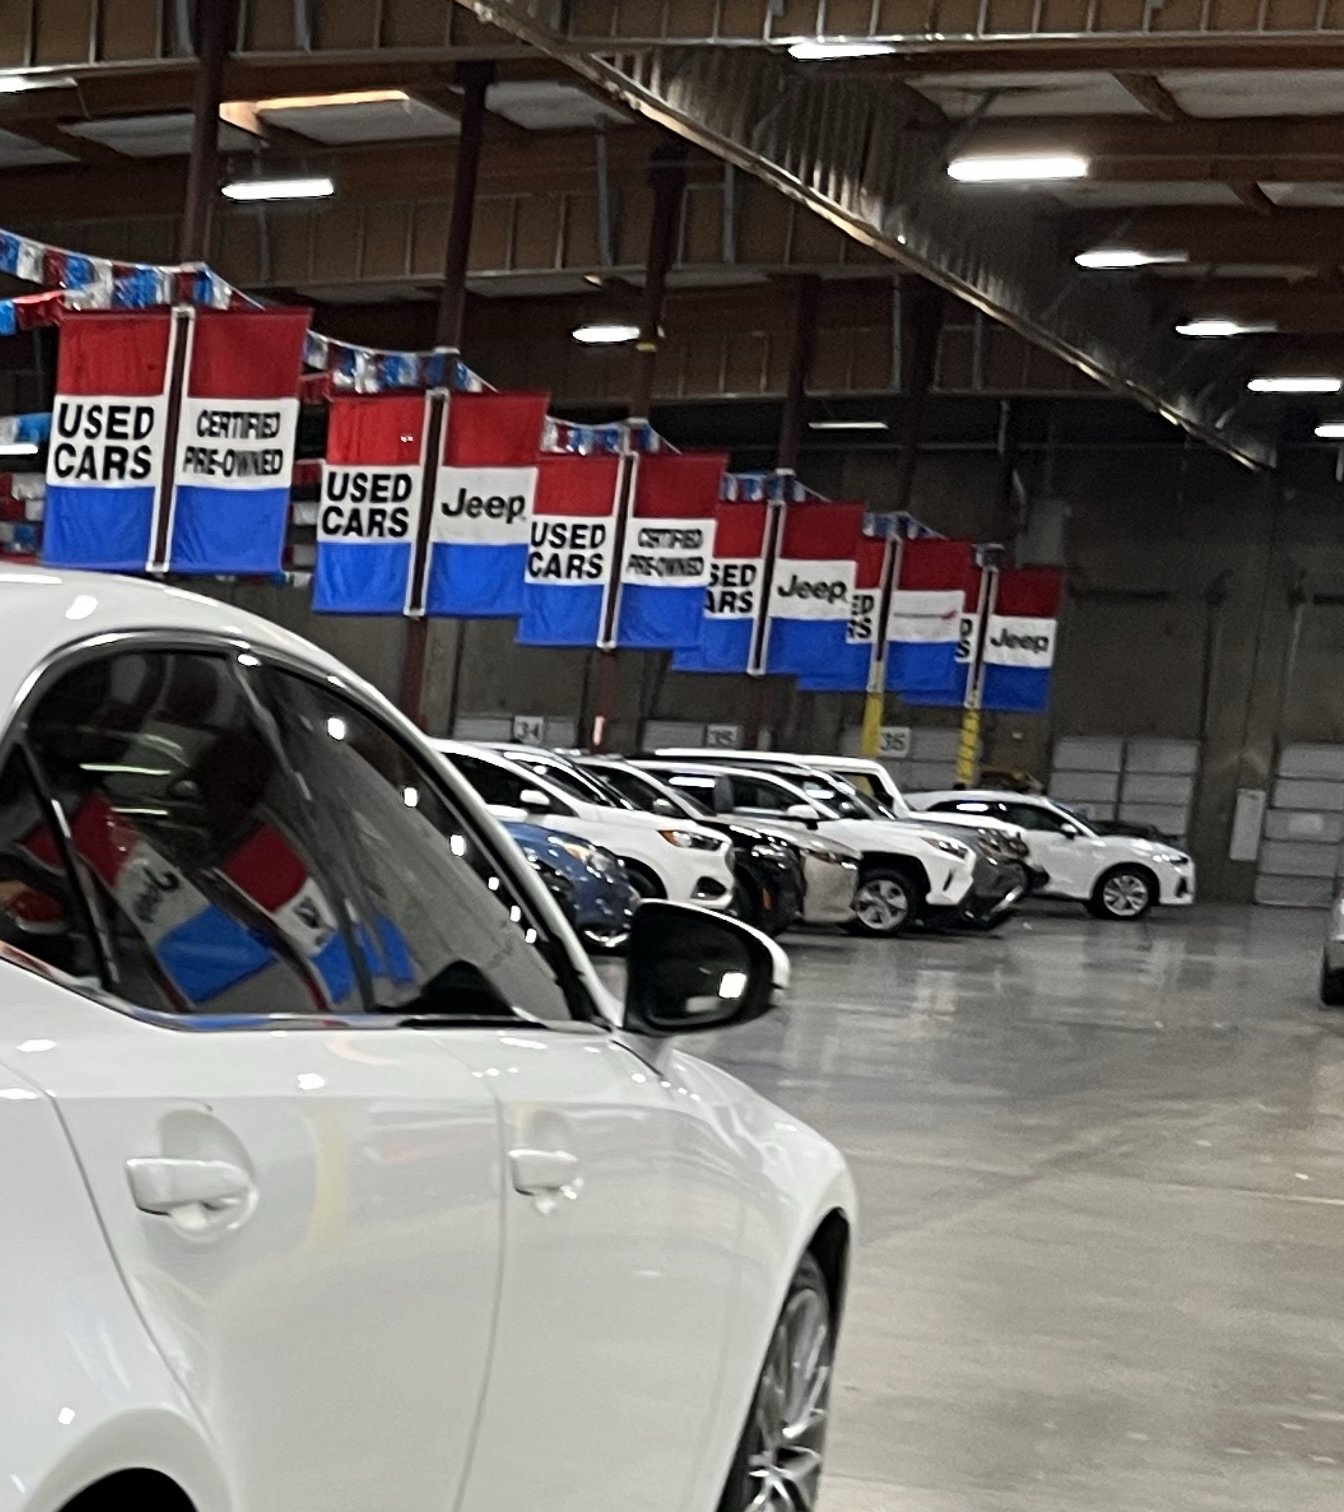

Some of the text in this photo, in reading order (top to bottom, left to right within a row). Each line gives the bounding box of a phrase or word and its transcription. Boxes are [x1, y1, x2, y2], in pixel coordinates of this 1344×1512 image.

[58, 403, 154, 442] USED
[197, 410, 281, 439] CERTIFIED
[53, 444, 152, 481] CARS
[182, 449, 284, 478] PRE-OWNED
[327, 472, 412, 503] USED
[441, 488, 526, 524] Jeep
[322, 506, 409, 537] CARS
[531, 522, 606, 549] USED
[527, 551, 603, 579] CARS
[709, 564, 757, 587] SED
[777, 574, 847, 604] Jeep
[990, 628, 1049, 654] Jeep
